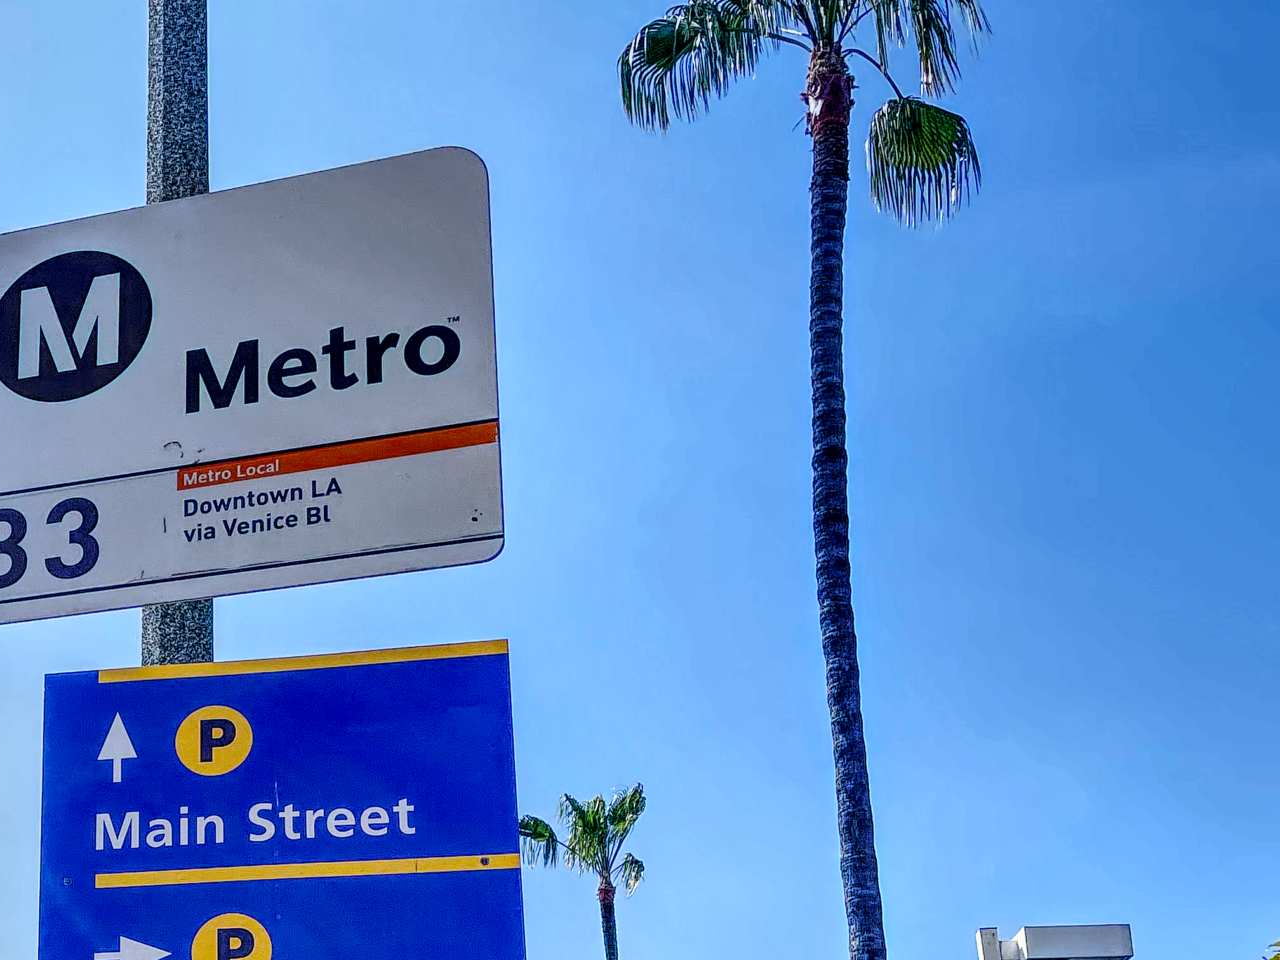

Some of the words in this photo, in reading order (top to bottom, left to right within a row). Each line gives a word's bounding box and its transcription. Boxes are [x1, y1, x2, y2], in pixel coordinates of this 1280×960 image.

[18, 273, 120, 381] M
[185, 325, 461, 414] Metro
[183, 466, 231, 486] Metro
[235, 459, 280, 480] Local
[183, 486, 303, 518] Downtown
[311, 477, 342, 499] LA
[184, 523, 216, 543] via
[222, 511, 299, 537] Venice
[306, 504, 331, 526] Bl
[199, 718, 237, 763] P
[95, 807, 225, 851] Main
[248, 798, 417, 843] Street
